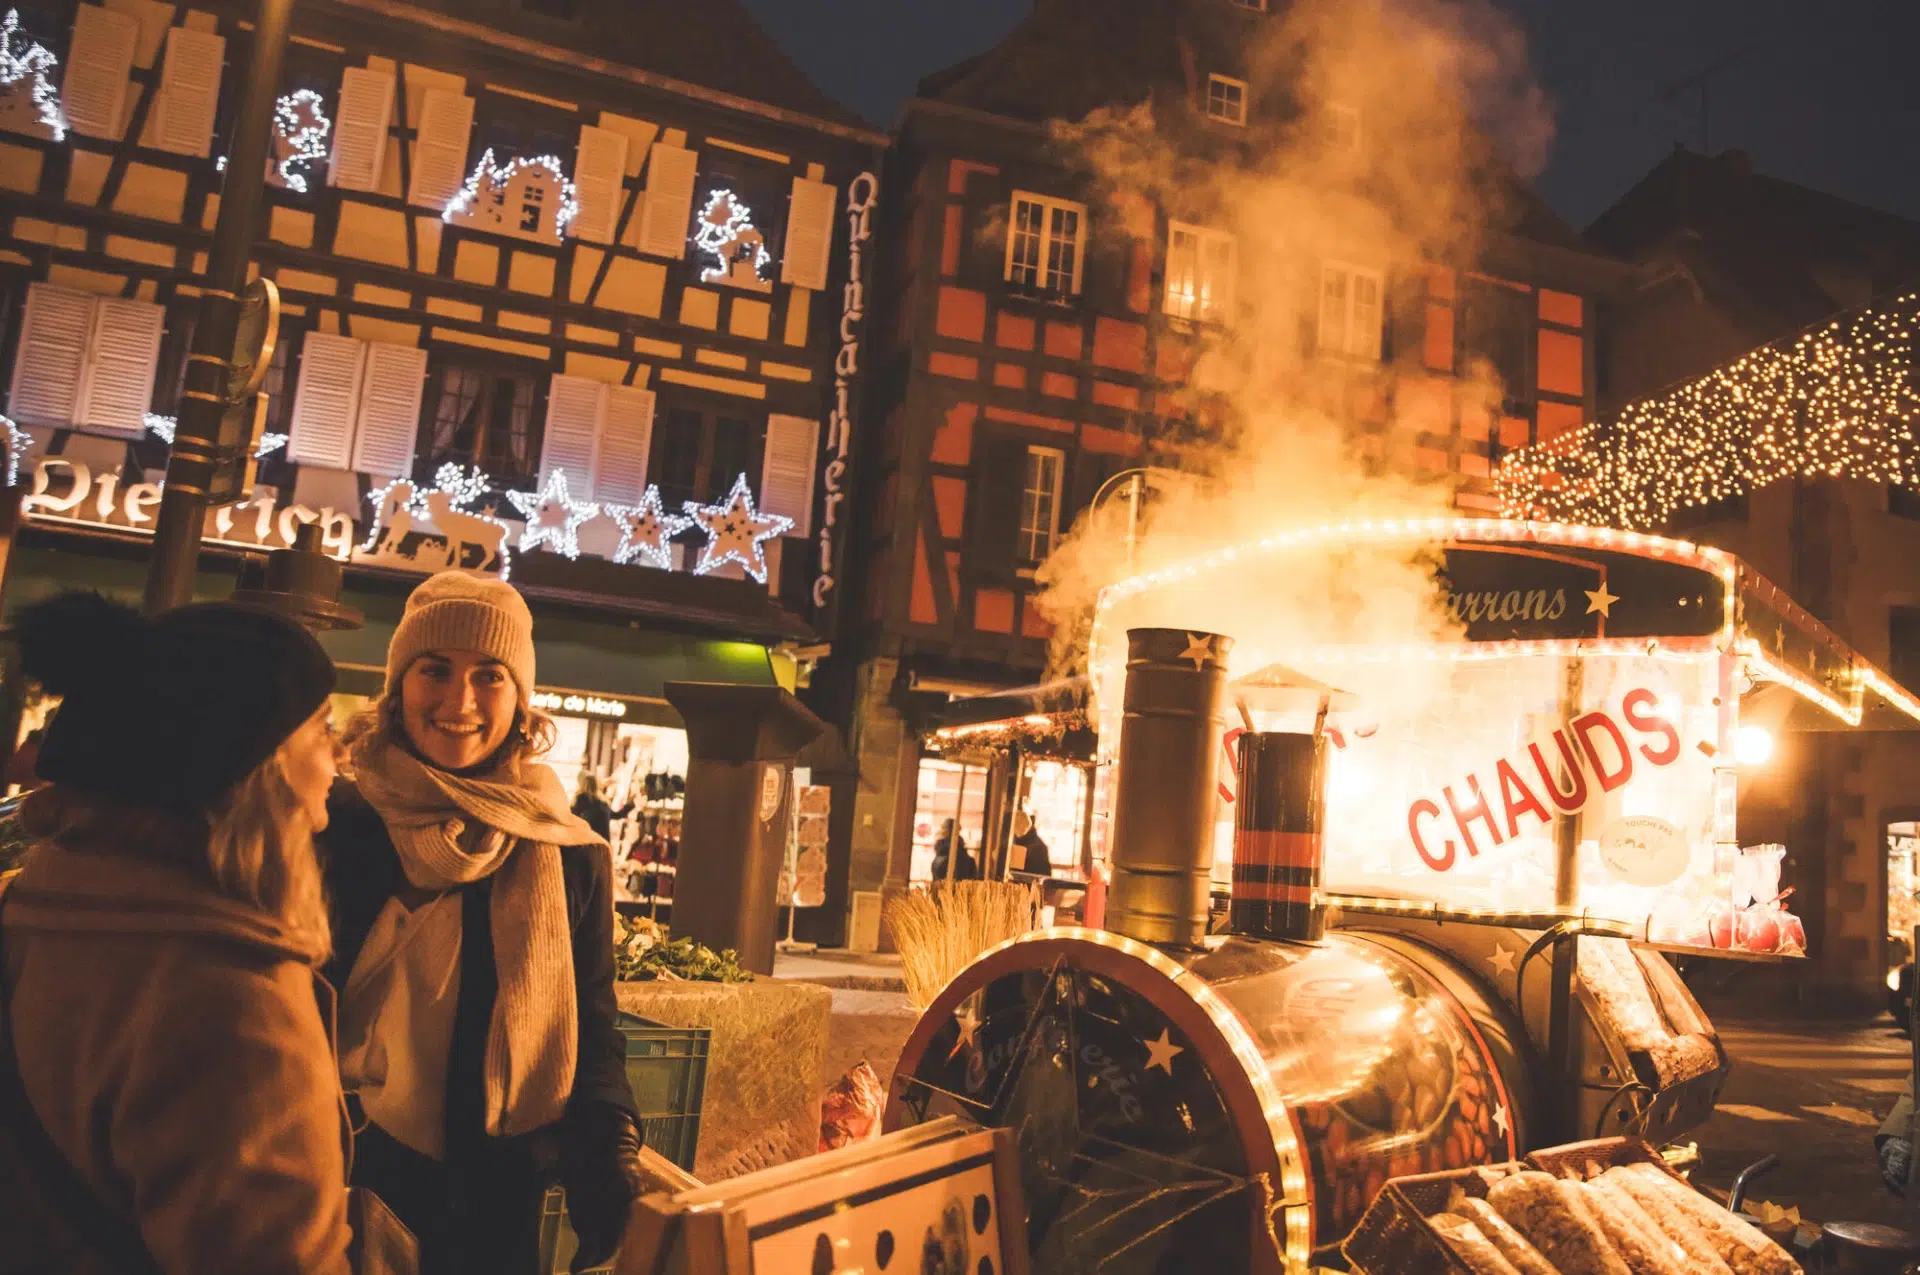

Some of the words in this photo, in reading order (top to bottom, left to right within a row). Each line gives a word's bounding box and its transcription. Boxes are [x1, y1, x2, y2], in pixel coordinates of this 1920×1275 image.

[813, 172, 878, 607] Quincaillerie
[1447, 588, 1567, 622] arrons
[564, 695, 585, 712] de
[587, 697, 626, 716] Marie
[1408, 687, 1681, 872] CHAUDS
